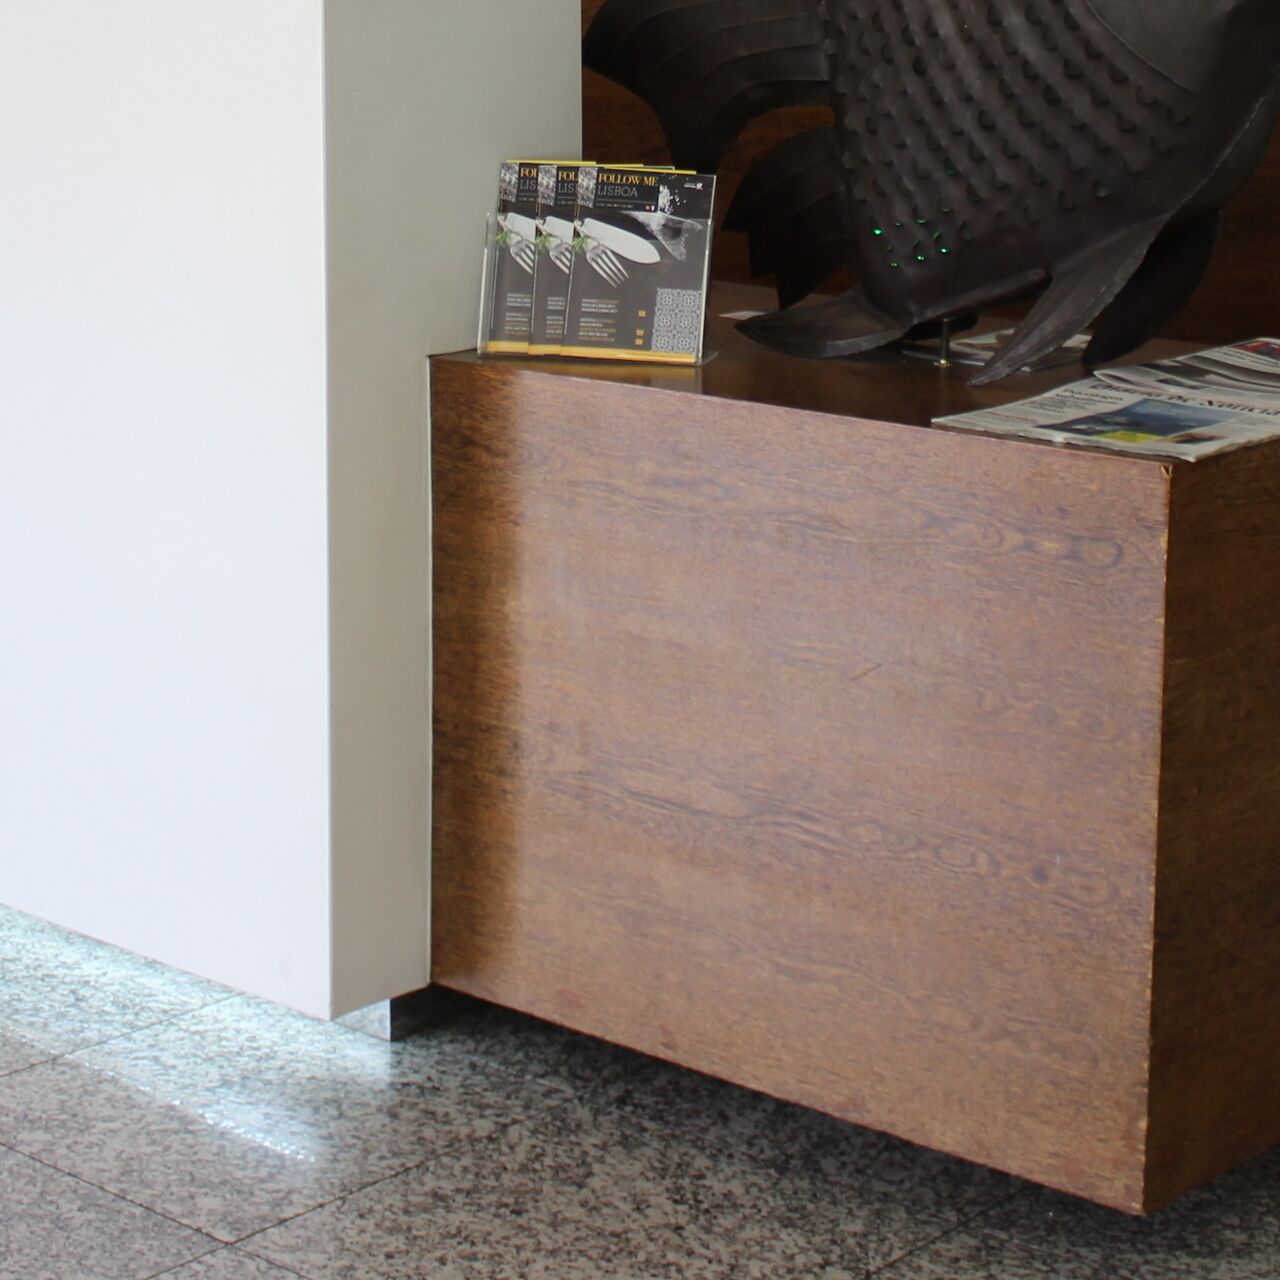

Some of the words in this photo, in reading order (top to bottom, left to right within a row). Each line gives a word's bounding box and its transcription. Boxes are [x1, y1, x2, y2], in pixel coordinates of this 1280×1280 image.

[599, 173, 641, 185] FOLLOW
[642, 176, 659, 187] ME
[597, 185, 639, 198] LISBOA
